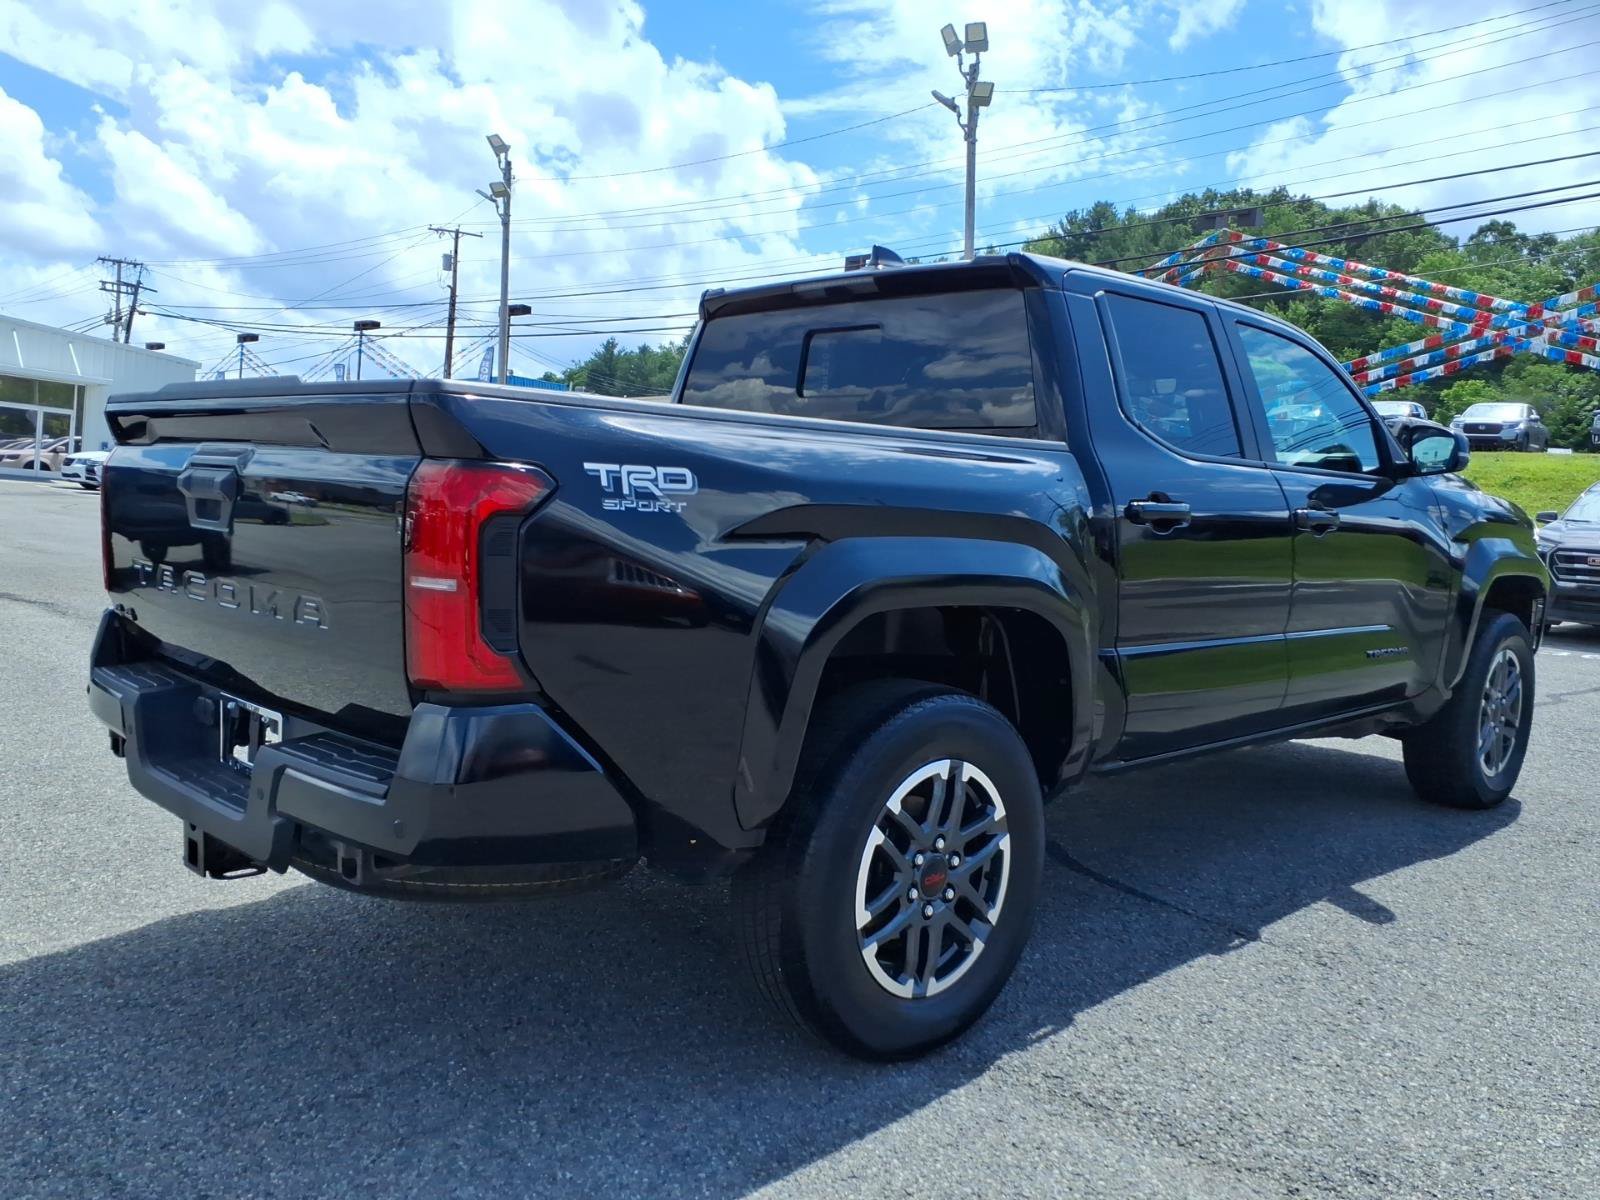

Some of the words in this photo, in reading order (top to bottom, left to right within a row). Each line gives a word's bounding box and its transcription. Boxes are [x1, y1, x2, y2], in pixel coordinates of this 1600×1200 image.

[583, 462, 698, 499] TRD
[602, 499, 687, 513] SPORT
[132, 558, 329, 630] TACOMA
